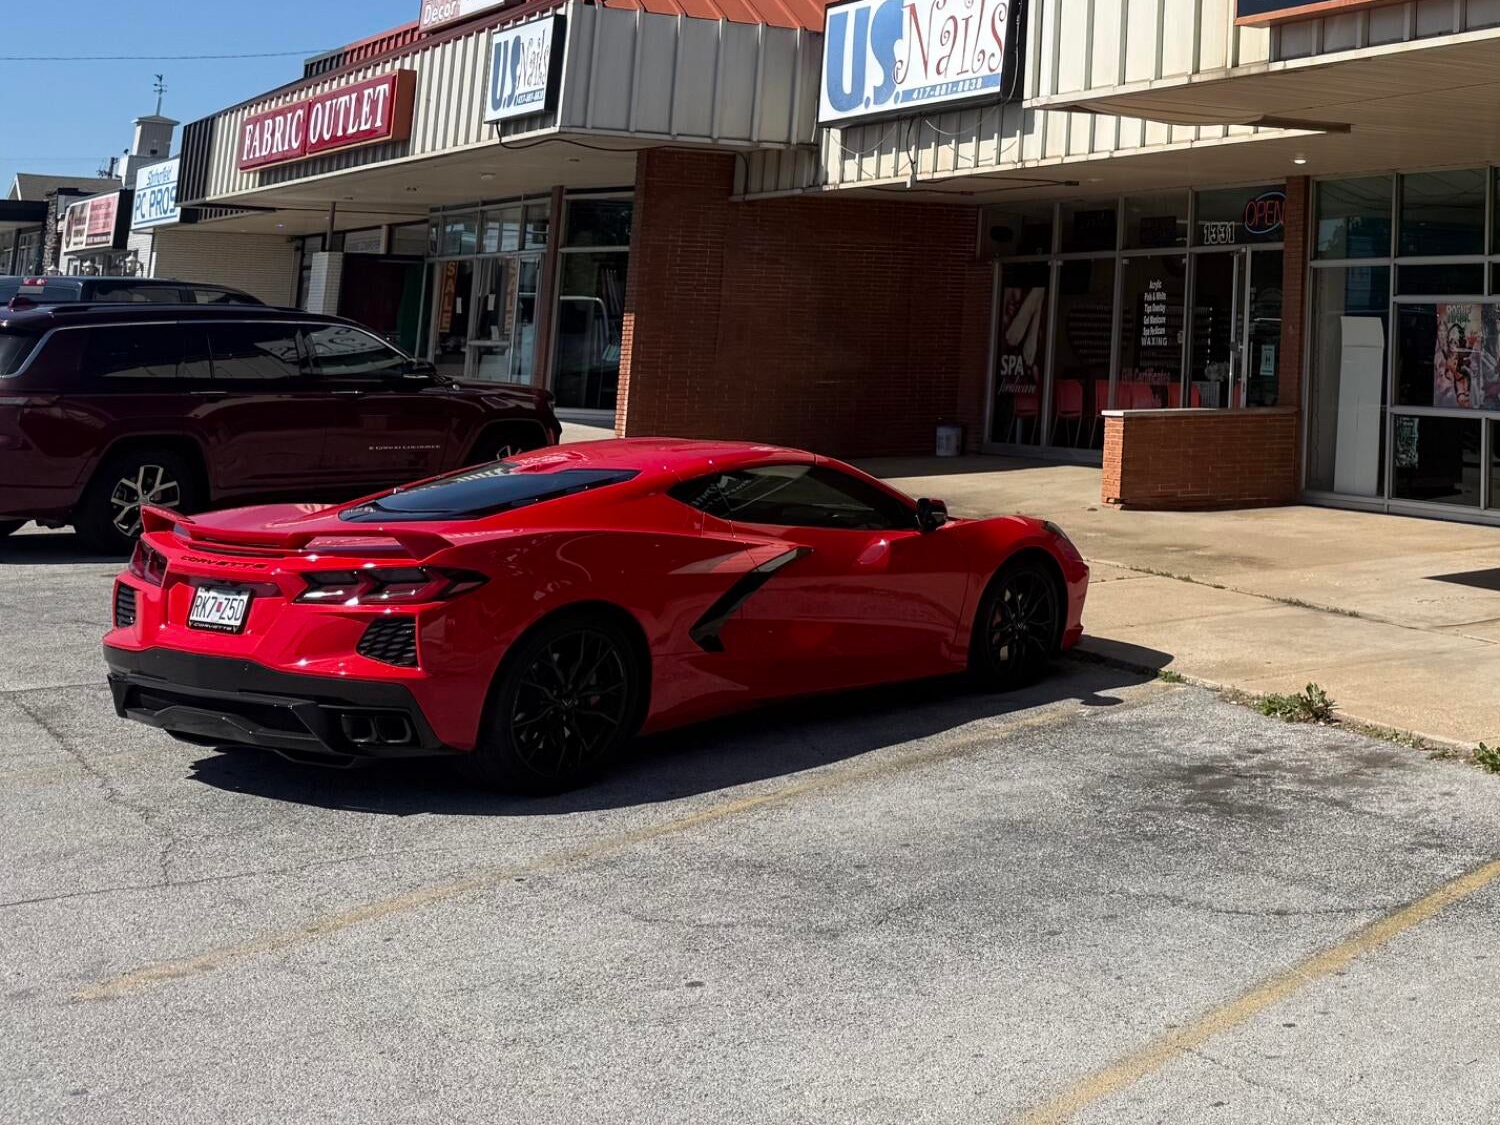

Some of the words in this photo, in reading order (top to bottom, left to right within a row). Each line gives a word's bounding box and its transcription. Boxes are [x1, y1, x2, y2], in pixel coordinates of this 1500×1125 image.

[423, 0, 457, 25] Decor
[242, 108, 304, 162] FABRIC
[309, 83, 390, 145] OUTLET
[134, 192, 147, 221] PC
[149, 186, 177, 218] PROS
[1245, 200, 1285, 228] OPEN
[1203, 221, 1236, 245] 1331
[441, 261, 457, 332] SALE
[1141, 337, 1168, 347] WAXING
[1000, 355, 1025, 376] SPA
